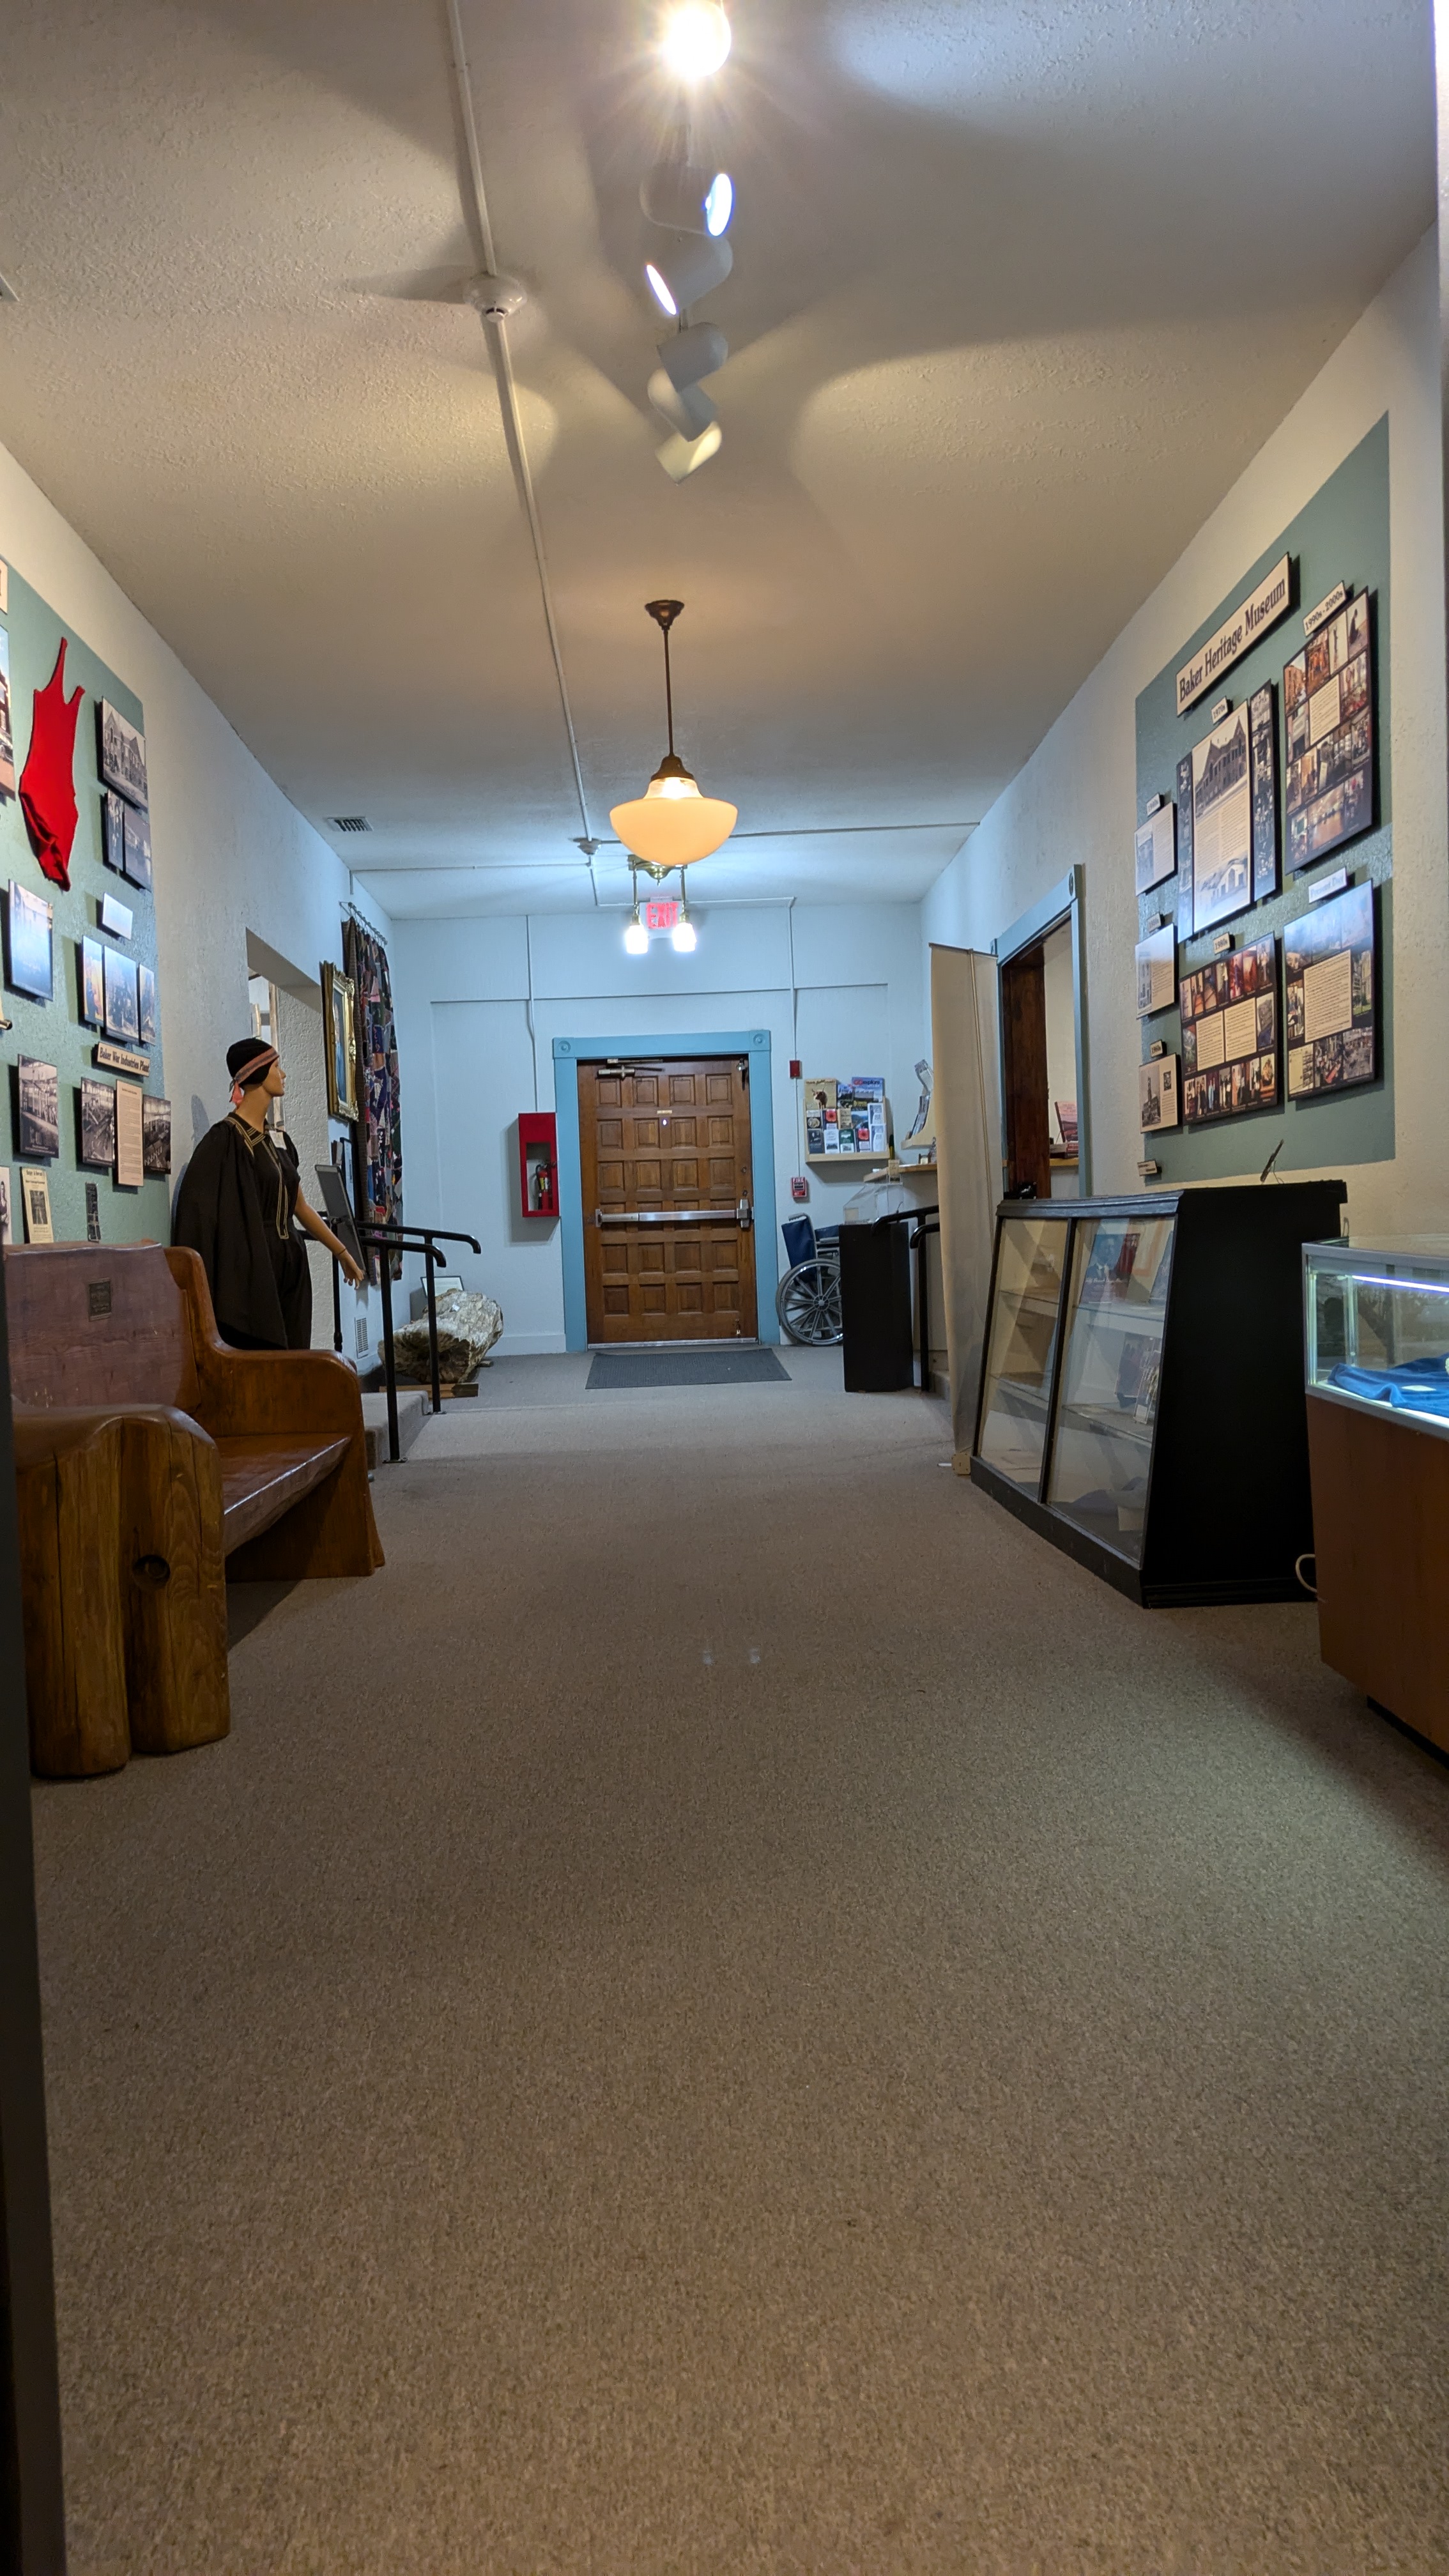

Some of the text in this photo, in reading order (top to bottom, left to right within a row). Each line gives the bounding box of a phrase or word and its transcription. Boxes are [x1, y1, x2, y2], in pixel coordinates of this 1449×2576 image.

[1305, 611, 1322, 630] 1990s
[1325, 591, 1343, 611] 2000s
[1179, 579, 1285, 703] Baker Heritage Museum
[1213, 704, 1226, 719] 1970s
[646, 901, 678, 930] EXIT
[100, 1047, 111, 1061] Baker
[121, 1054, 139, 1070] Industries
[140, 1060, 150, 1073] Plant
